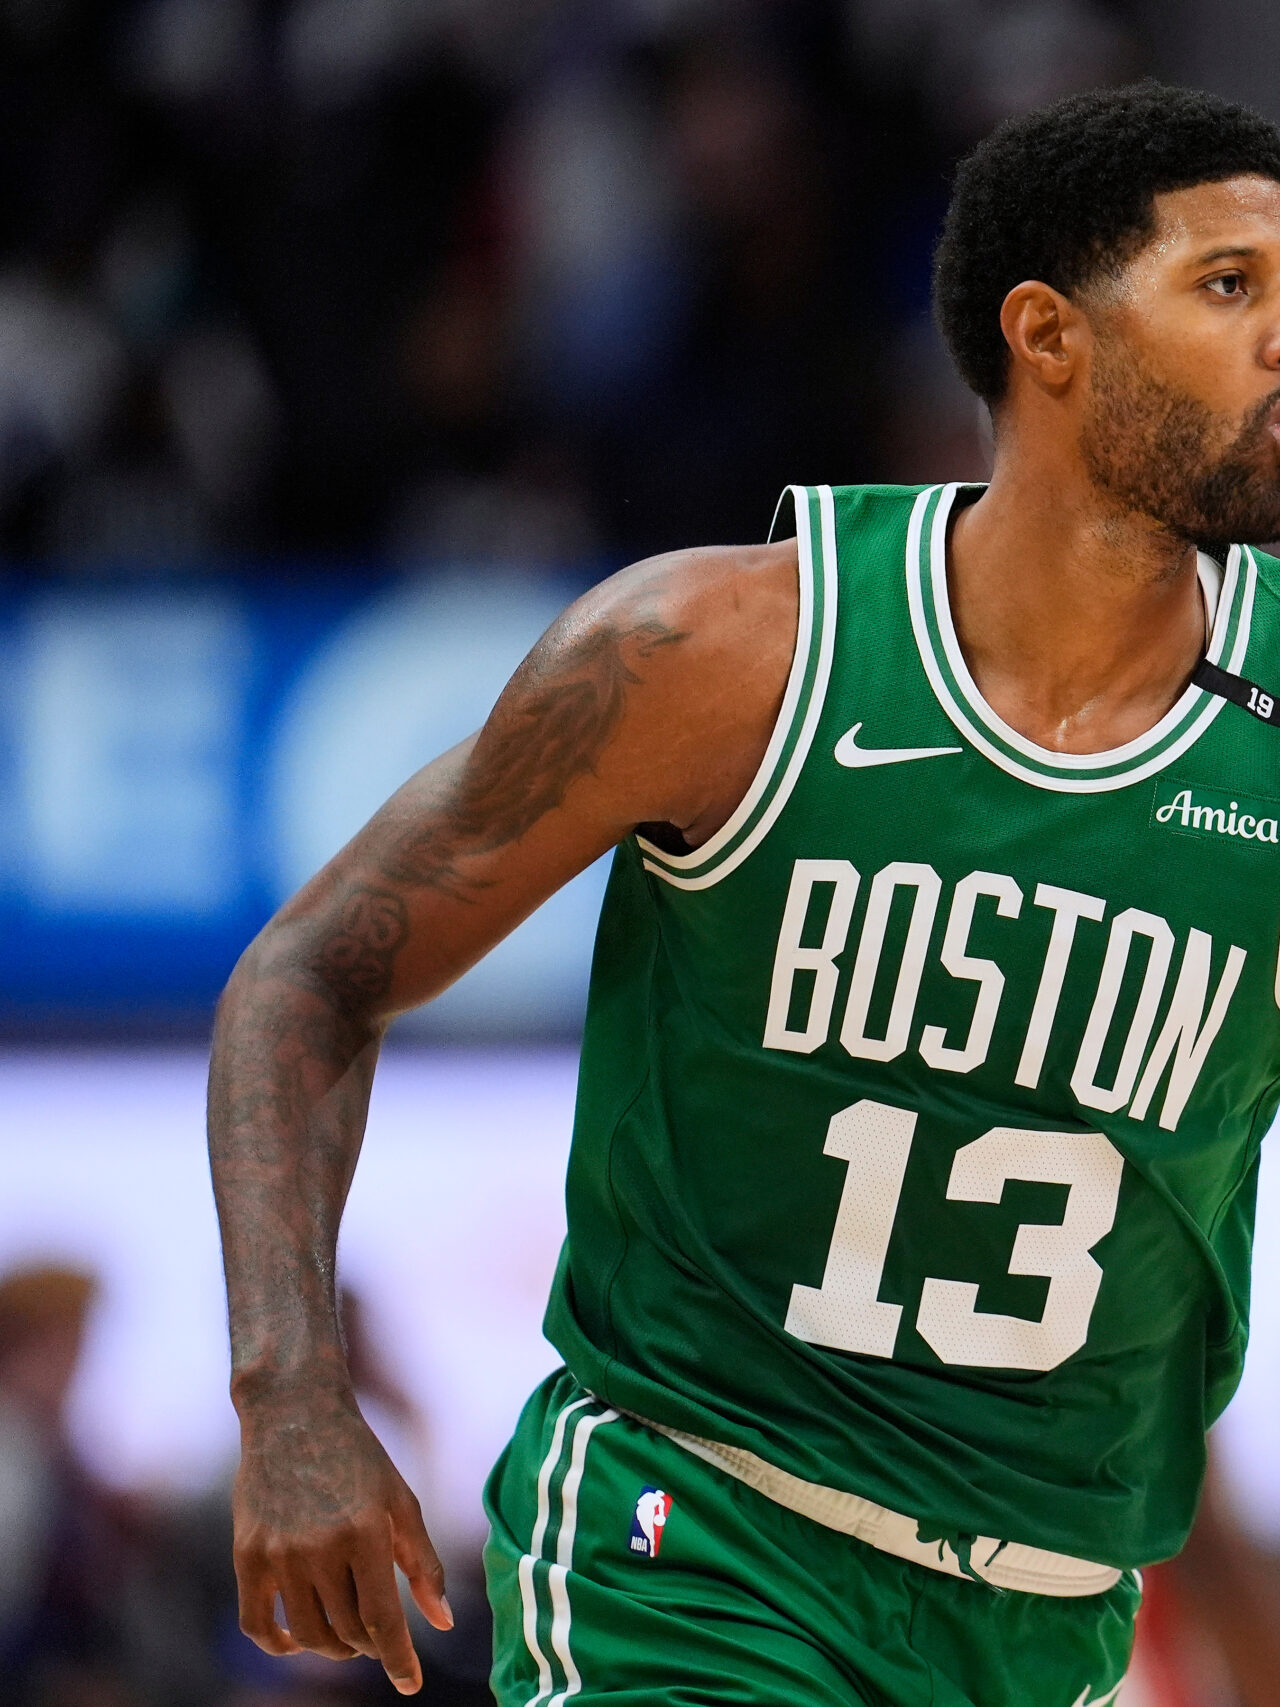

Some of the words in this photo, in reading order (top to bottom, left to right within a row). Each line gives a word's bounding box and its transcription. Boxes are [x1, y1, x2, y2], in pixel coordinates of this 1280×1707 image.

[1247, 687, 1275, 719] 19
[1156, 790, 1278, 843] Amica
[763, 859, 1247, 1132] BOSTON
[784, 1099, 1124, 1371] 13
[630, 1536, 648, 1553] NBA
